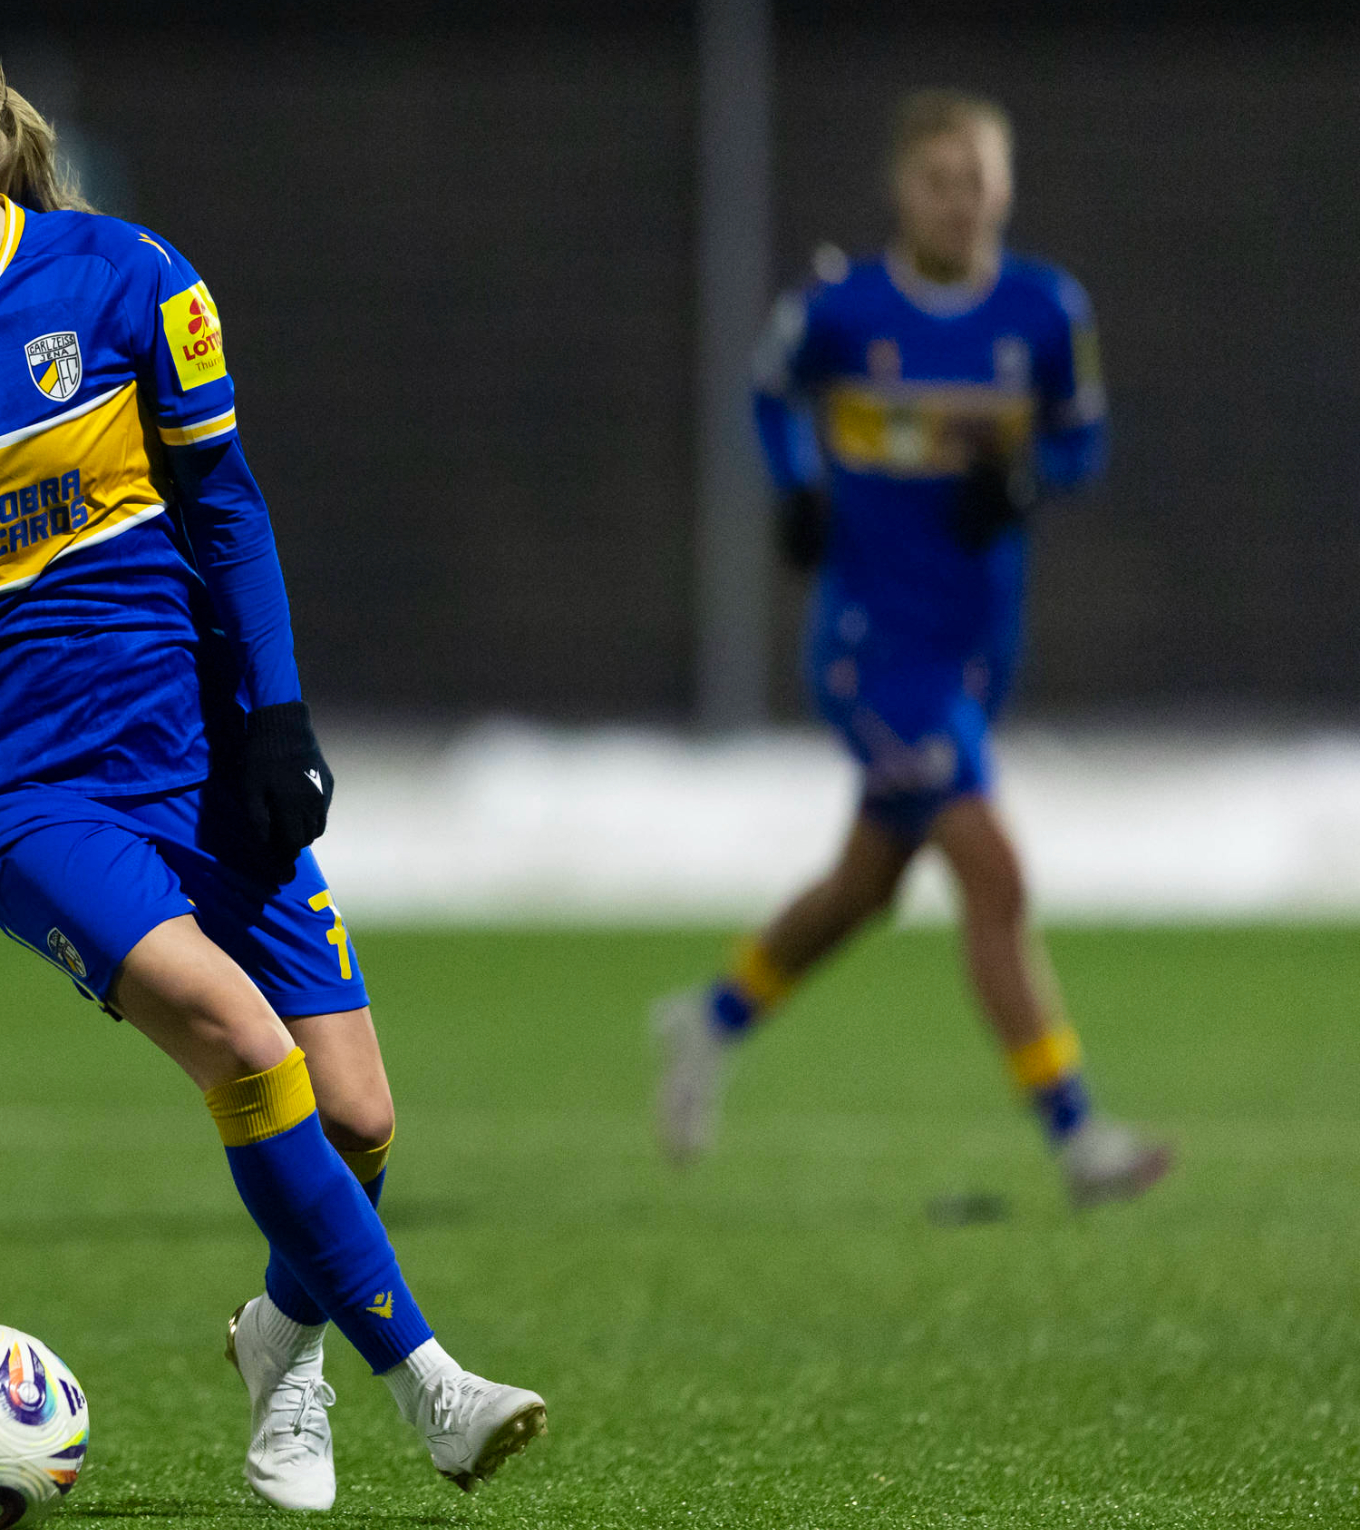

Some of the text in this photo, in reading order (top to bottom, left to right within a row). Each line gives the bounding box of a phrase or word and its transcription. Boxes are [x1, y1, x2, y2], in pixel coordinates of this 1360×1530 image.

[29, 335, 75, 354] CARL ZEISS
[40, 348, 69, 362] JENA
[183, 331, 222, 361] LOTT
[58, 356, 78, 394] FC
[307, 888, 352, 980] 7
